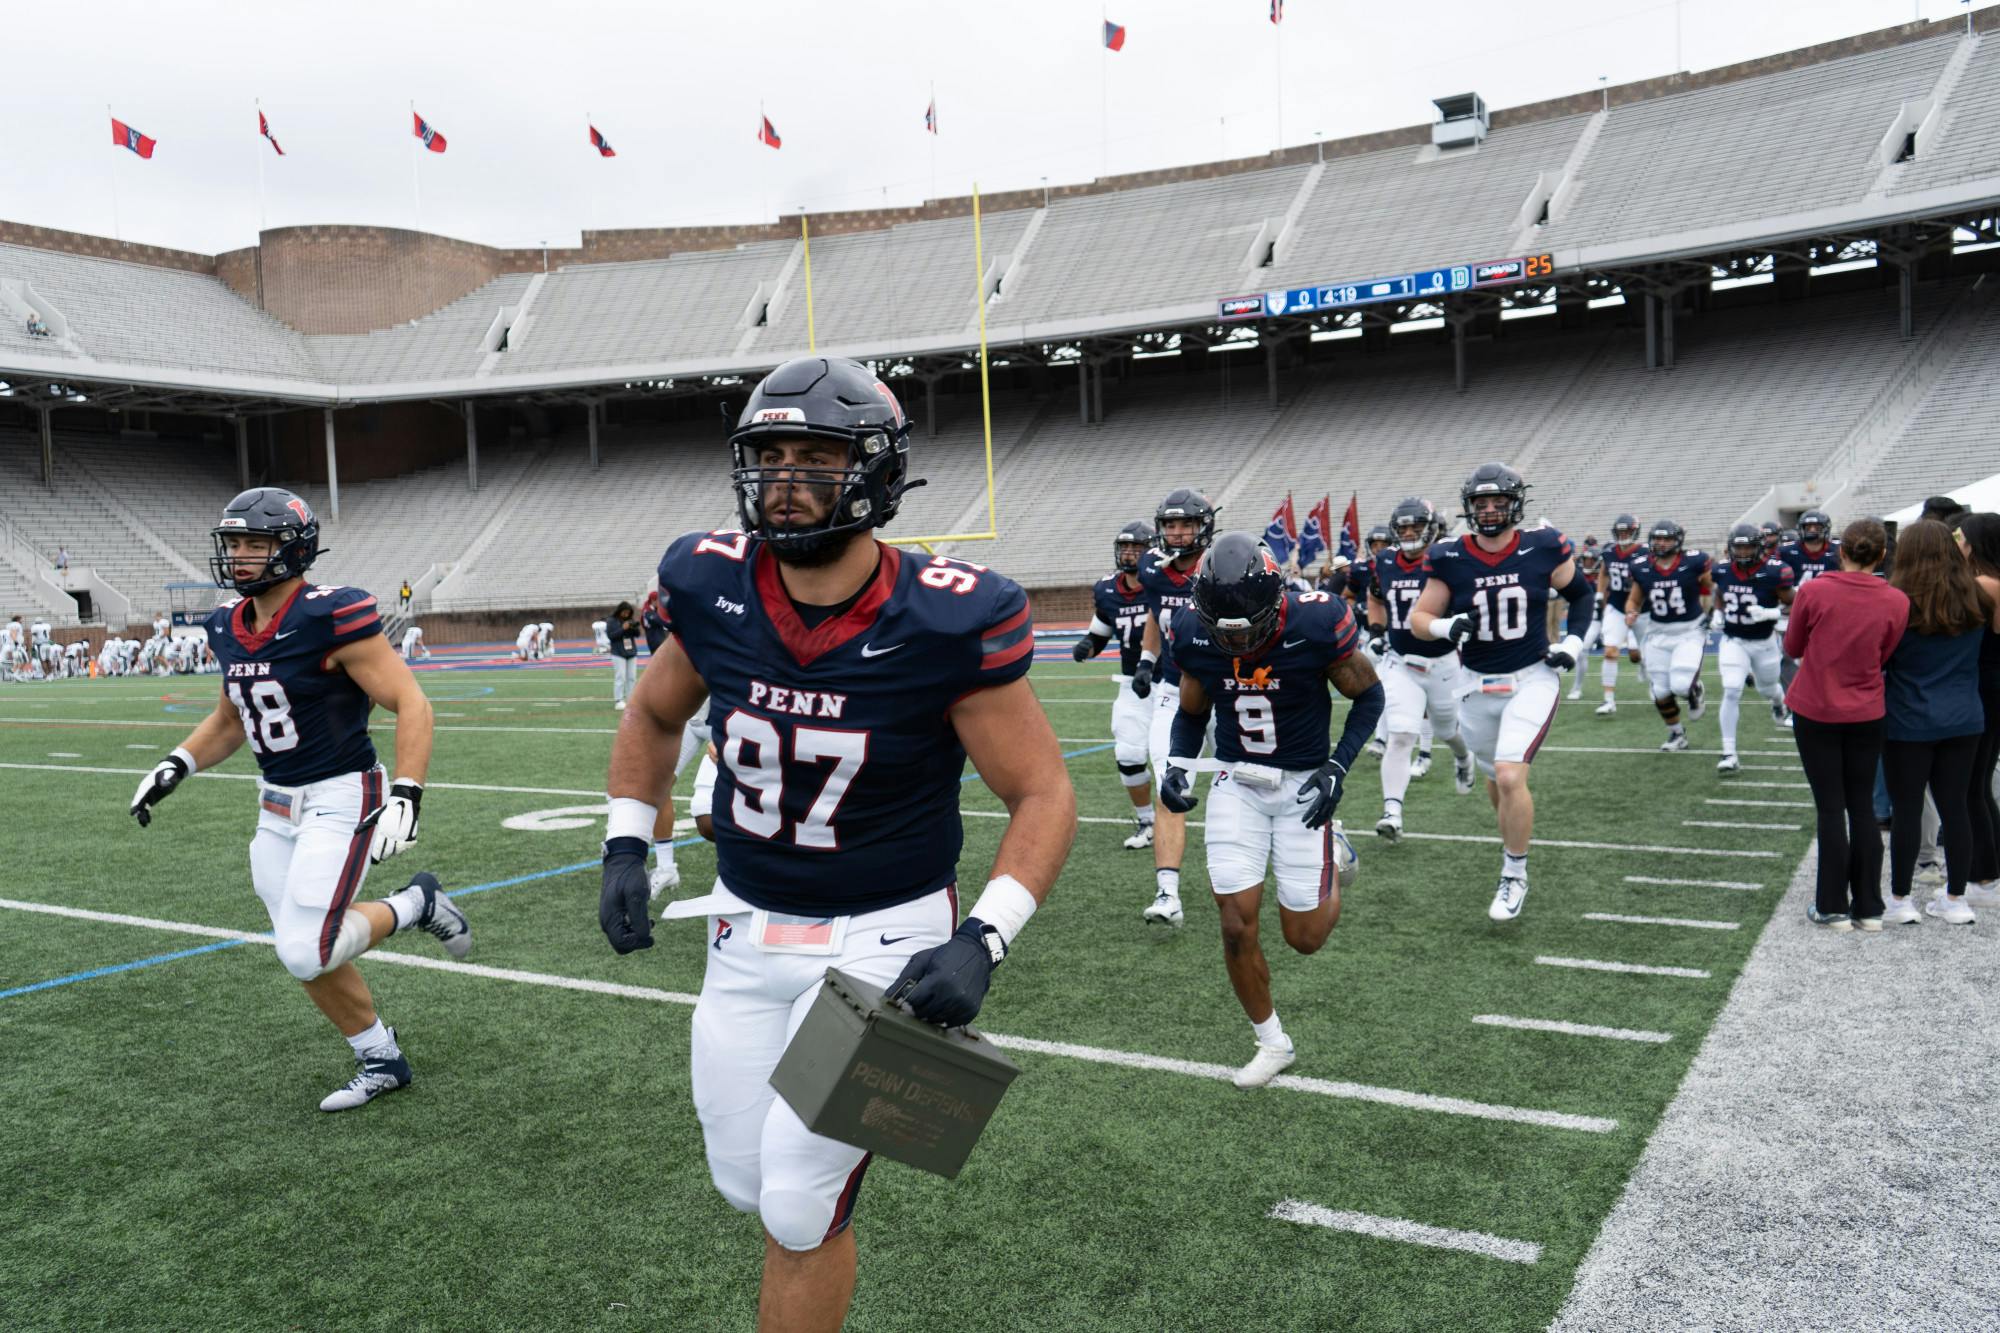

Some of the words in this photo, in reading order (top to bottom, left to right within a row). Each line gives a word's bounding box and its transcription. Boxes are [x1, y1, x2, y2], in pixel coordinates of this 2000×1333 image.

[1527, 255, 1552, 276] 25
[1400, 279, 1409, 296] 1
[1432, 272, 1443, 289] 0
[1298, 291, 1310, 305] 0
[1323, 286, 1357, 304] 4:19
[1391, 580, 1420, 588] PENN
[1474, 573, 1519, 588] PENN
[715, 596, 737, 613] Ivy
[1387, 589, 1421, 630] 17
[1650, 586, 1686, 616] 64
[1472, 585, 1528, 641] 10
[228, 662, 271, 677] PENN
[749, 681, 847, 719] PENN
[228, 680, 300, 754] 48
[1234, 695, 1278, 755] 9
[722, 708, 872, 850] 97
[849, 1061, 906, 1096] PENN
